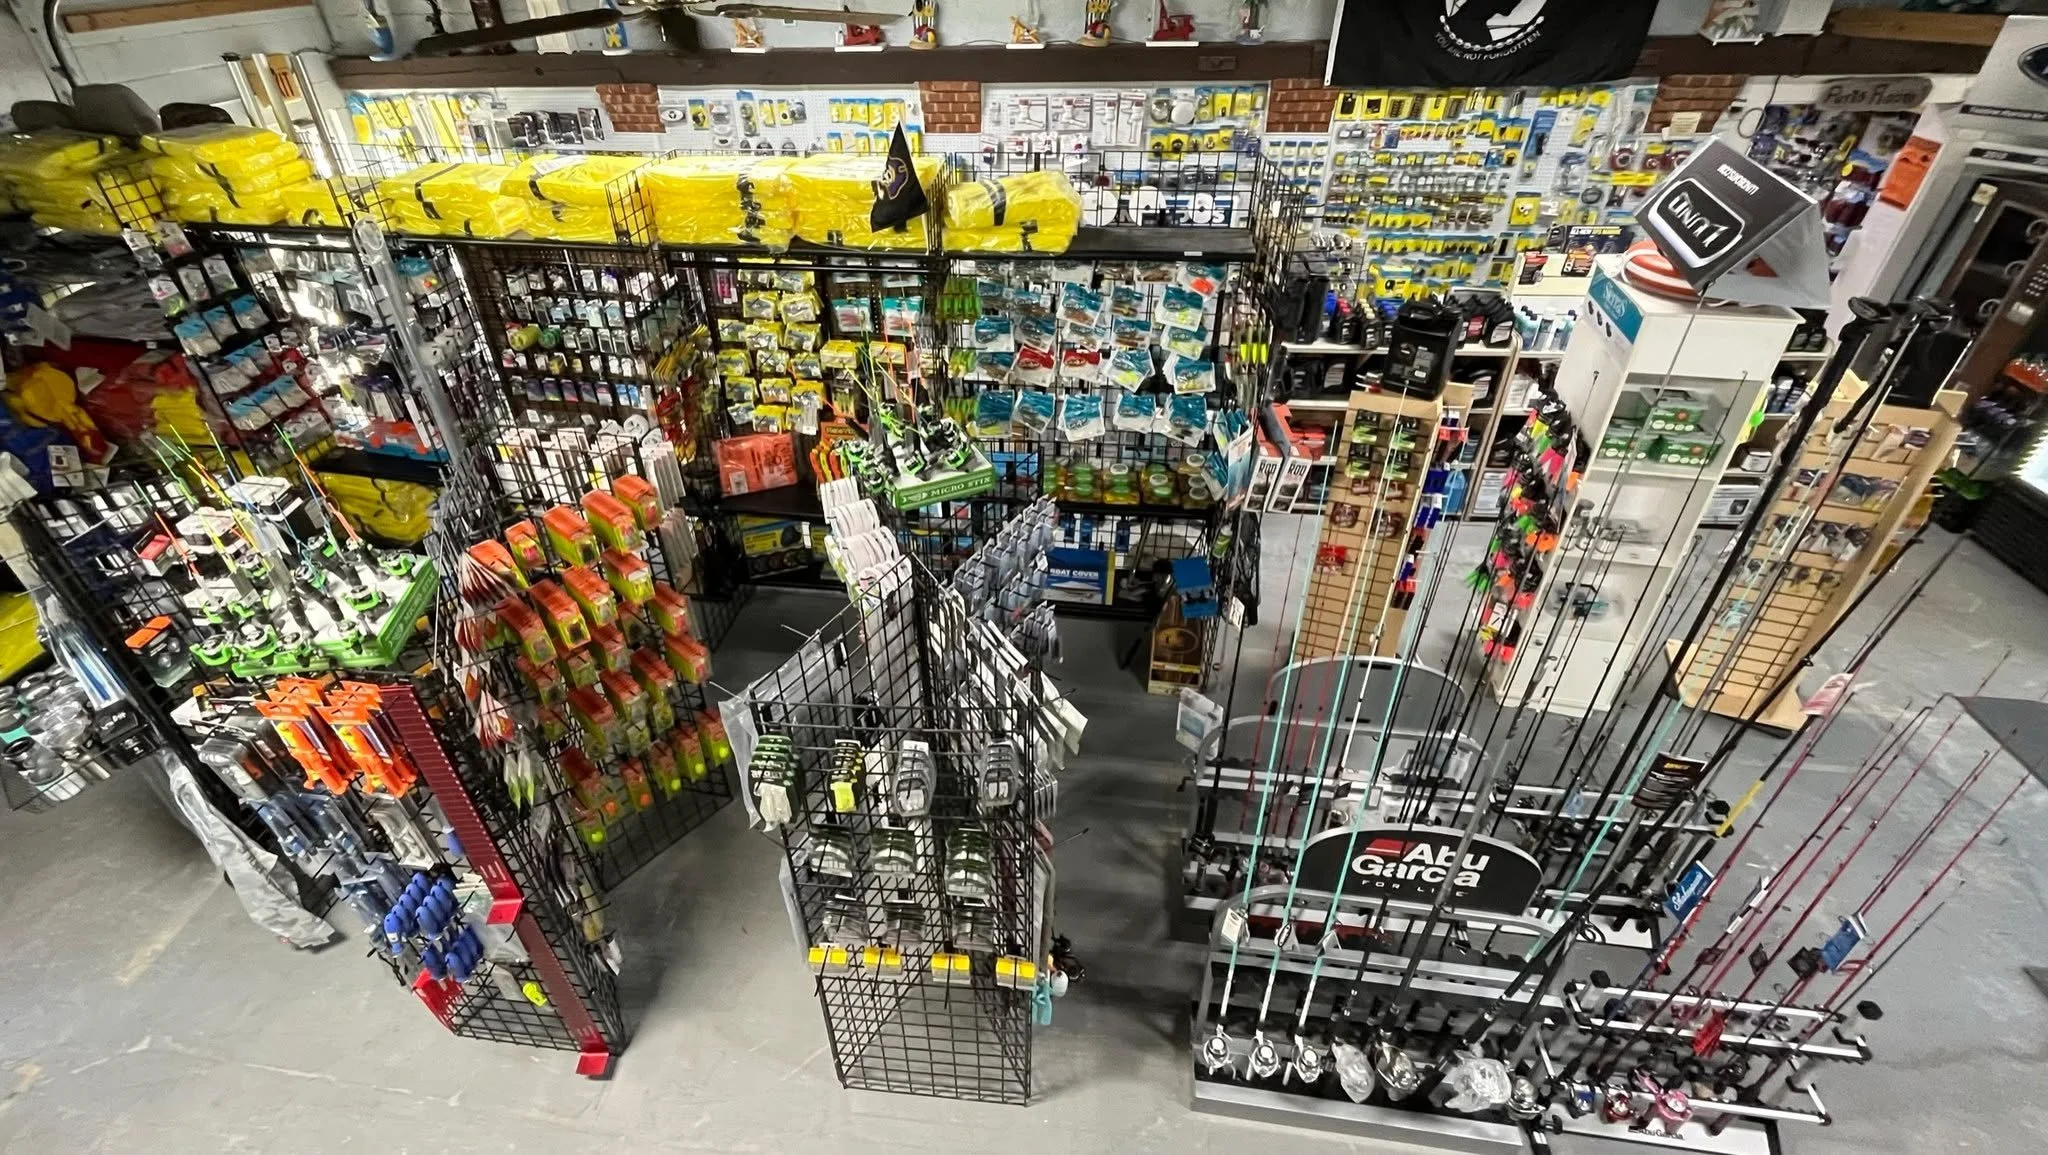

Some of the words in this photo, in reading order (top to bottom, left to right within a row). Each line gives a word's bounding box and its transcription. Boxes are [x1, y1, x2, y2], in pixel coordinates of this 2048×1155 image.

[1434, 32, 1449, 48] YOU
[1463, 52, 1483, 61] NOT
[1483, 30, 1541, 61] FORGOTTEN
[1668, 190, 1729, 249] LUND
[1258, 462, 1278, 475] ROD
[1287, 462, 1308, 476] ROD
[930, 483, 965, 497] MICRO
[967, 476, 991, 488] STIX
[1072, 569, 1099, 578] COVER
[1403, 842, 1490, 871] Abu
[1351, 854, 1481, 888] Garca
[1361, 879, 1401, 889] FOR
[1416, 886, 1470, 897] LIE
